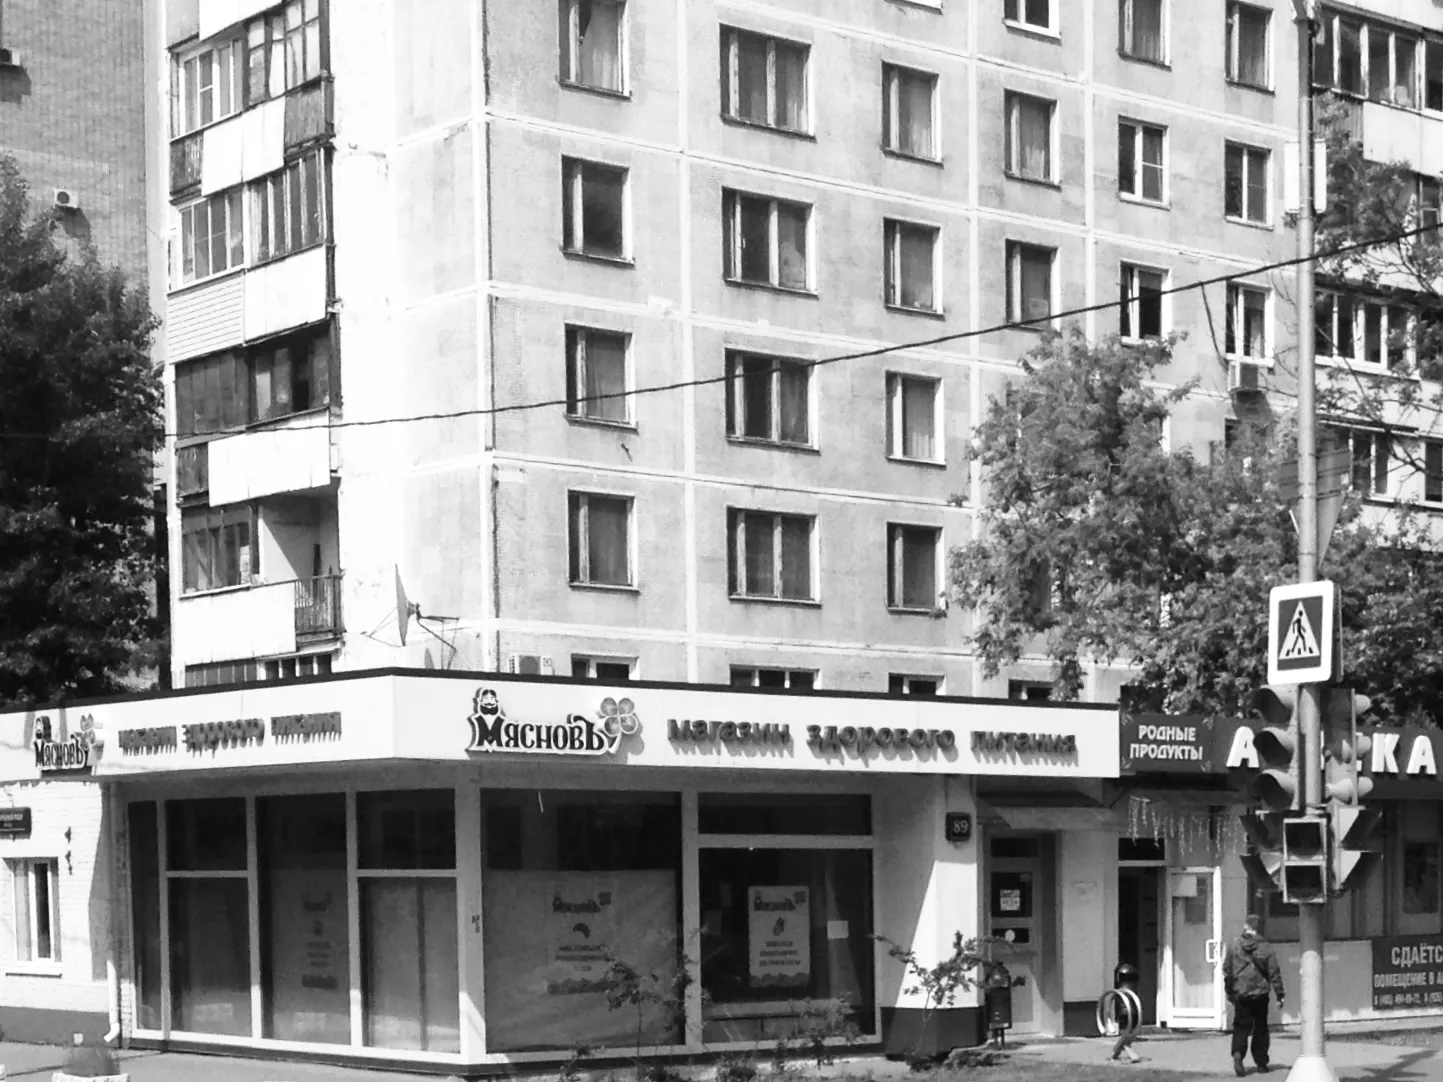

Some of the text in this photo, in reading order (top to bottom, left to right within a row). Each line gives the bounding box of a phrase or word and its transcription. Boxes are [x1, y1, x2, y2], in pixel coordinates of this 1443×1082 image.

[1138, 724, 1197, 741] РОДНЫЕ
[806, 724, 957, 761] здорового
[1226, 725, 1437, 774] АКА
[1129, 743, 1203, 760] ПРОДУКТЫ
[952, 819, 969, 834] 89
